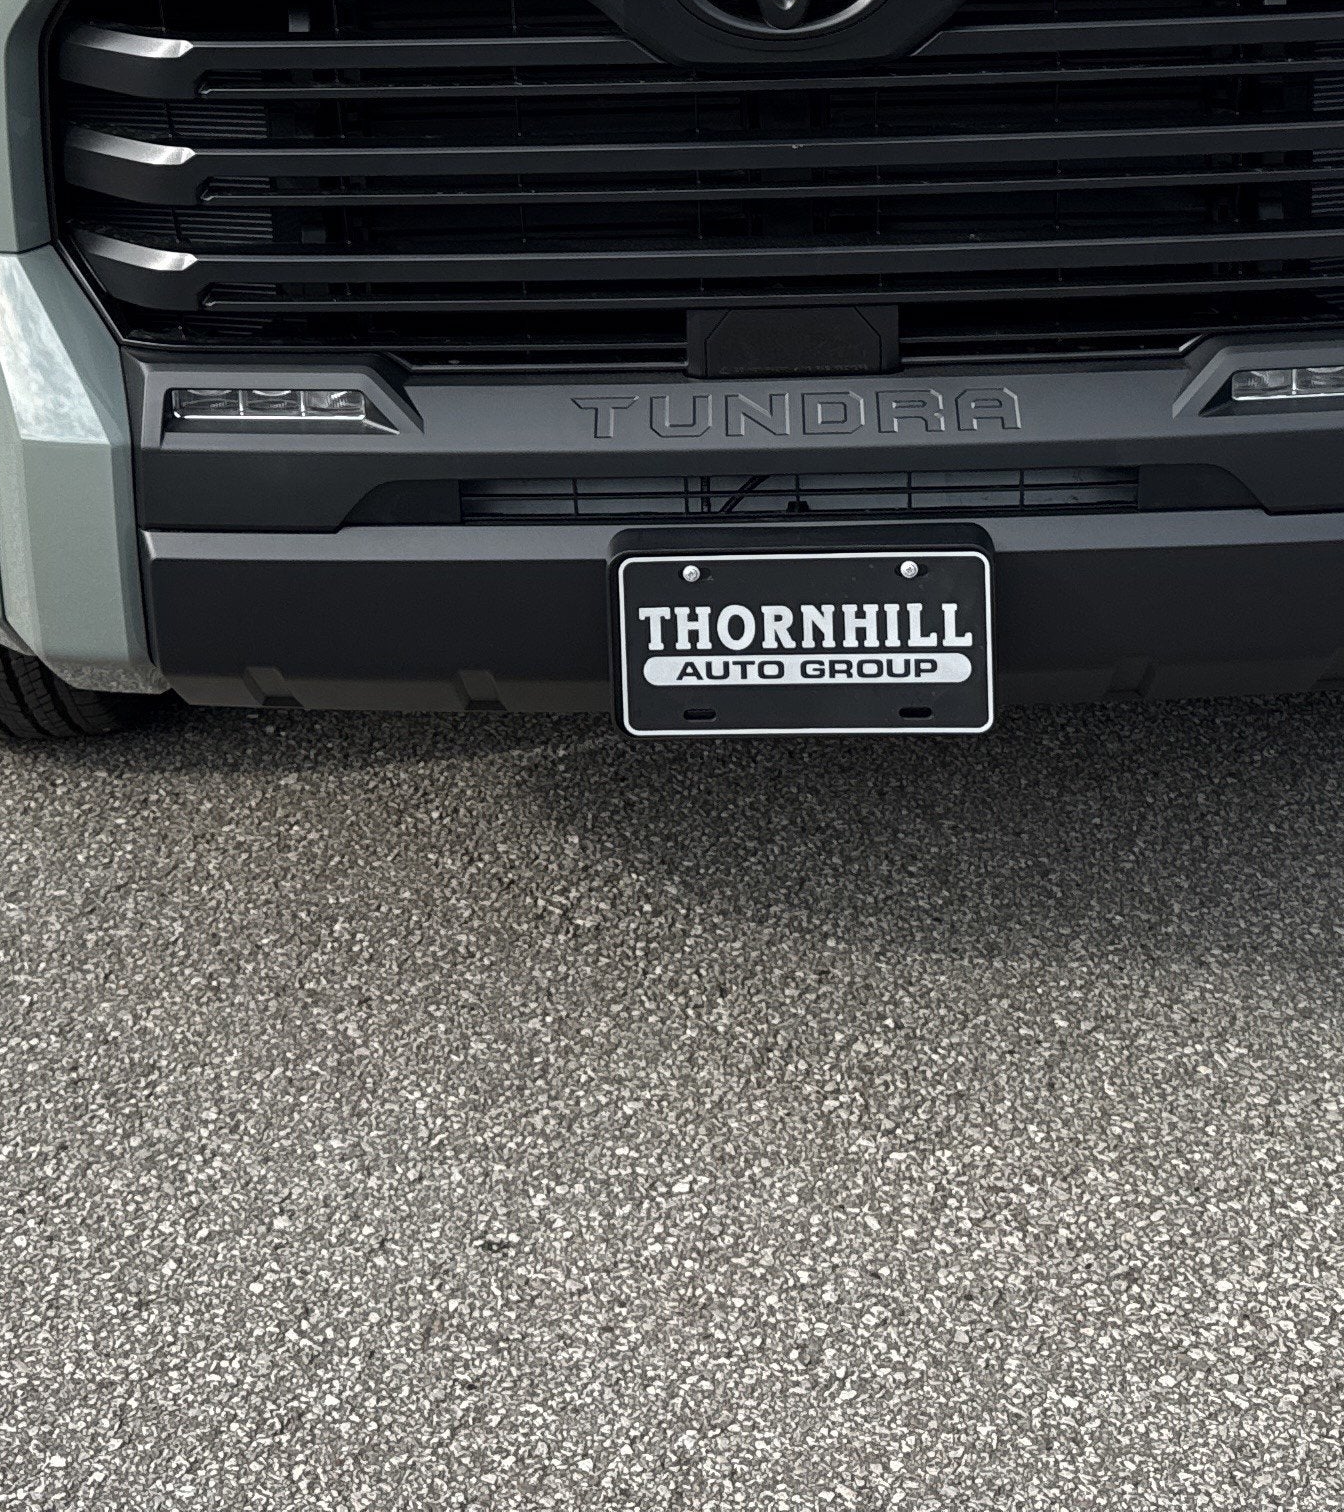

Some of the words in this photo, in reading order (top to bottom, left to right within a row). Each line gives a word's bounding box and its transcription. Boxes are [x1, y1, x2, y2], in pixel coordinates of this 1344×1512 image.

[570, 388, 1022, 439] TUNDRA
[638, 602, 973, 651] THORNHILL
[676, 659, 785, 681] AUTO
[799, 657, 939, 680] GROUP
